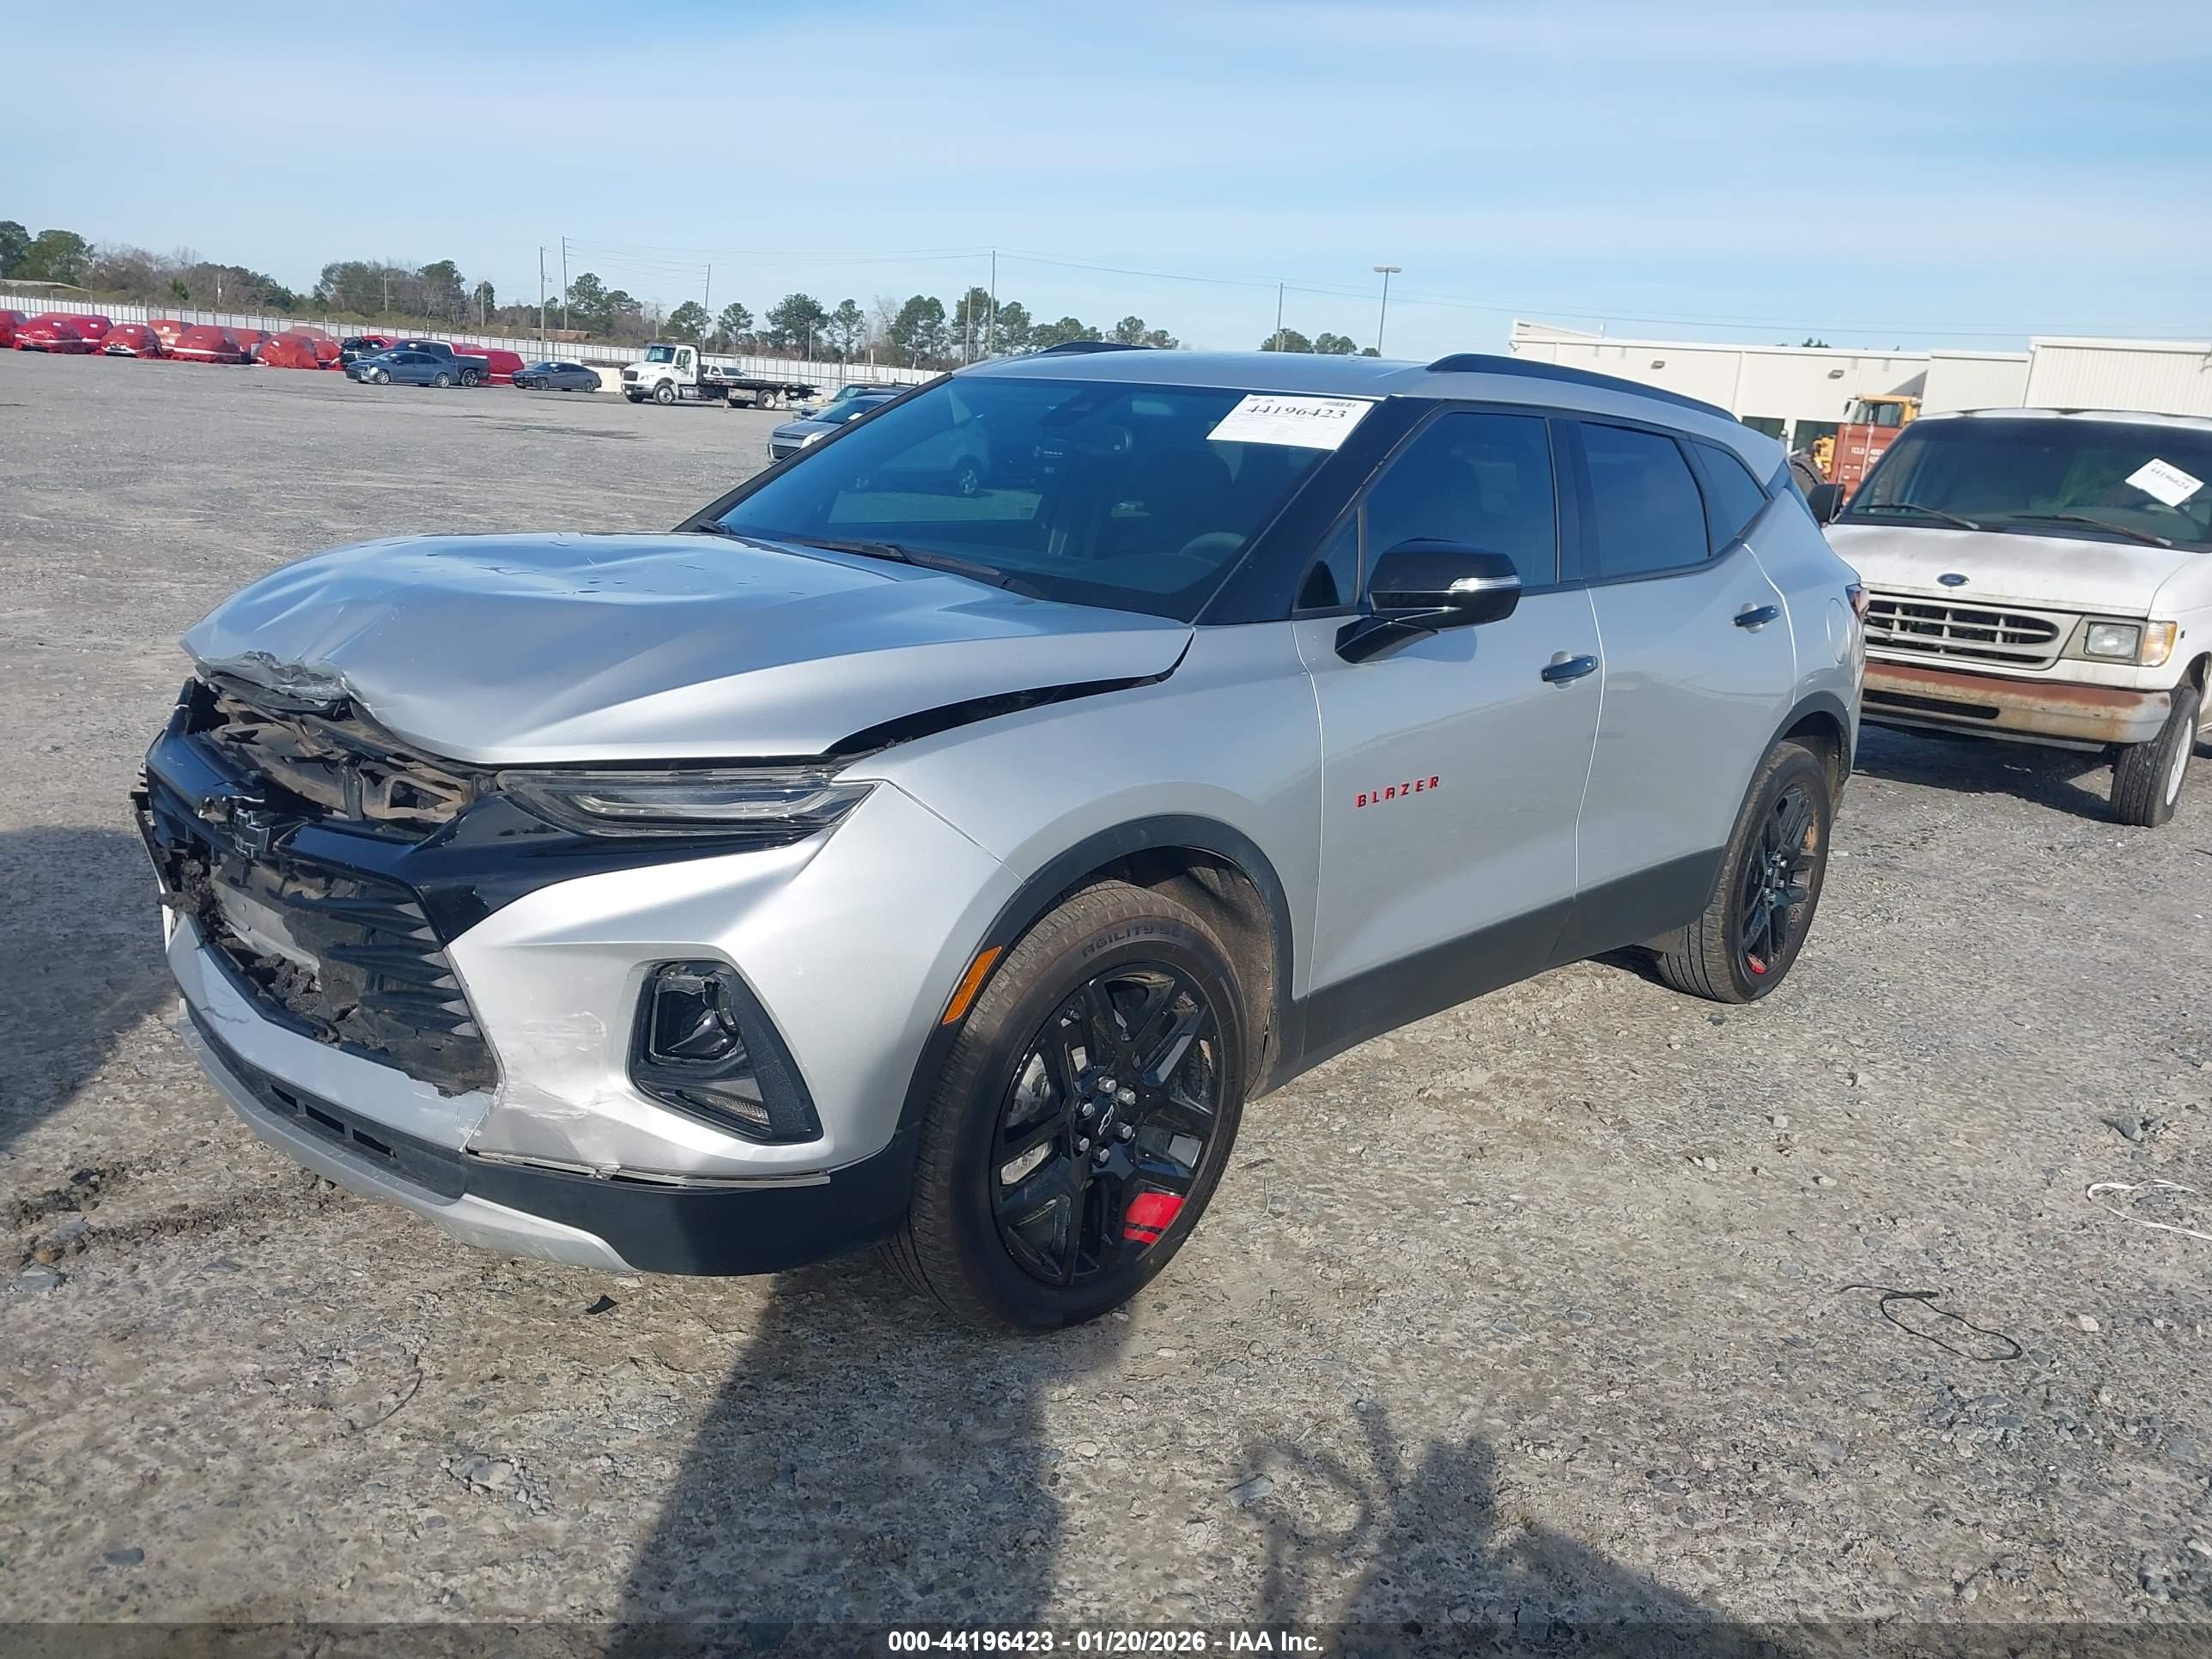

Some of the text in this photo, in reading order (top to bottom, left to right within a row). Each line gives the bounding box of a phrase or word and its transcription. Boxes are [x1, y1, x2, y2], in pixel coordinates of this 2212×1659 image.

[1246, 404, 1347, 420] 44196423
[1356, 775, 1440, 808] BLAZER
[1082, 925, 1154, 958] AGILITY
